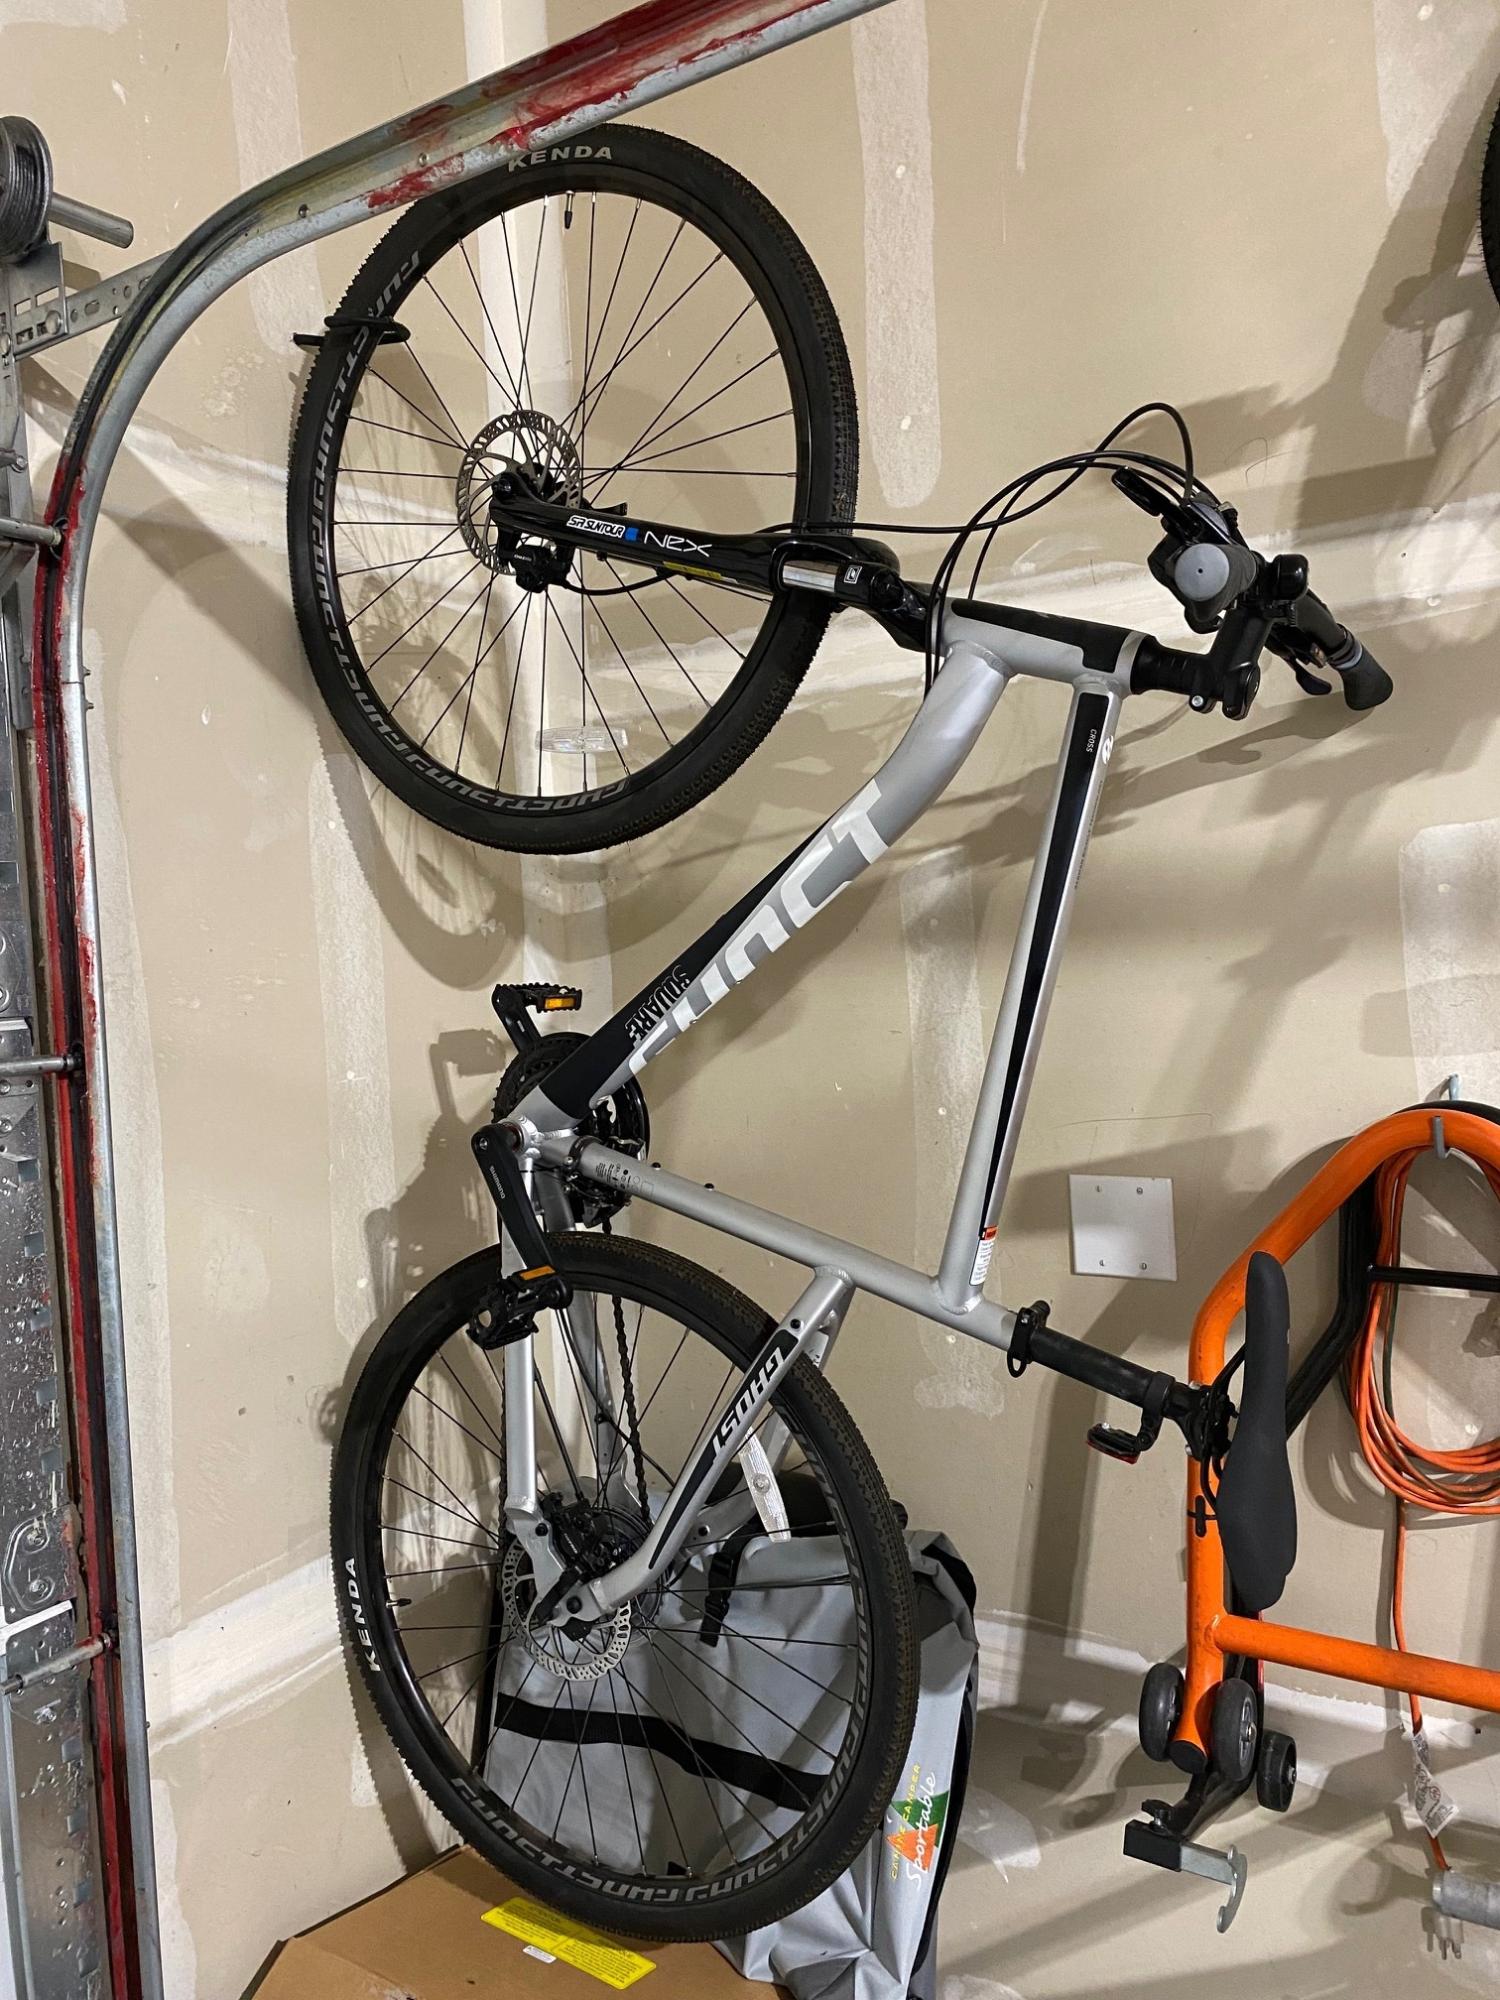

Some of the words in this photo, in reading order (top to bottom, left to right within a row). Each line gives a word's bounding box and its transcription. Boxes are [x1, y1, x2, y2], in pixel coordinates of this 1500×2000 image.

[508, 146, 612, 172] KENDA
[566, 515, 585, 530] SR
[584, 518, 625, 538] SUNTOUR
[1085, 728, 1097, 752] CROSS
[624, 963, 691, 1049] SQUARE
[712, 1347, 784, 1459] GHOST
[345, 1558, 380, 1672] KENDA
[906, 1772, 936, 1890] Sportable
